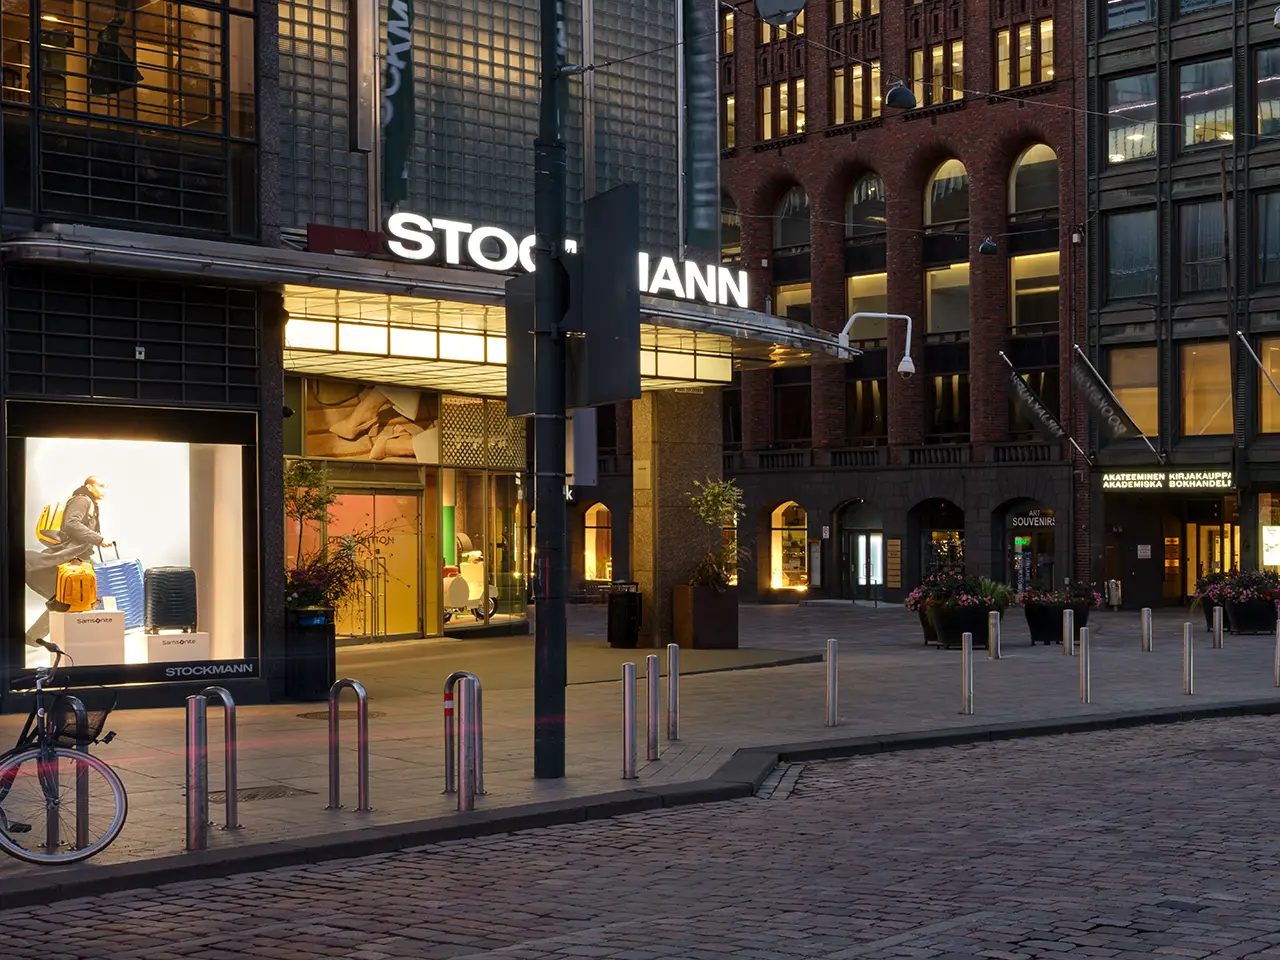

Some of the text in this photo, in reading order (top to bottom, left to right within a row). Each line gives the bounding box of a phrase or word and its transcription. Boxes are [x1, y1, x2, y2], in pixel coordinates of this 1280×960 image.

[387, 212, 748, 308] STOANN
[1103, 473, 1165, 481] AKATEEMINEN
[165, 663, 253, 677] STOCKMANN
